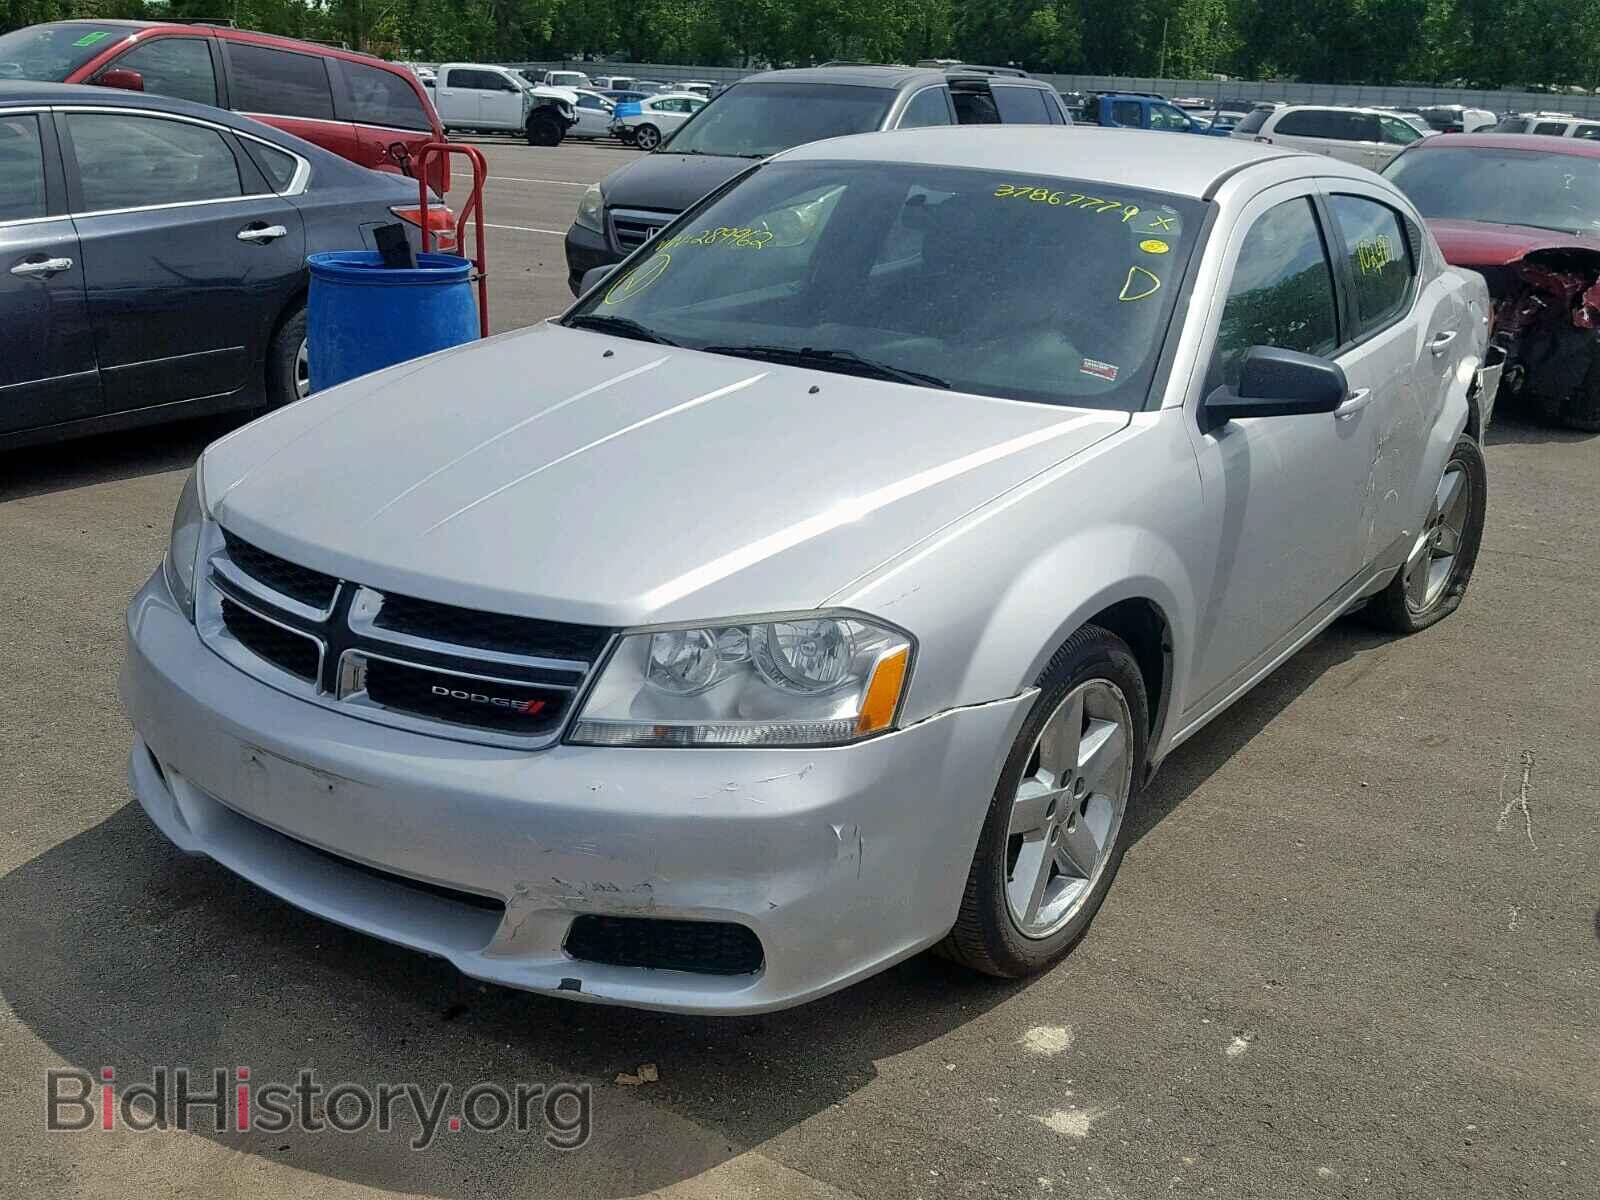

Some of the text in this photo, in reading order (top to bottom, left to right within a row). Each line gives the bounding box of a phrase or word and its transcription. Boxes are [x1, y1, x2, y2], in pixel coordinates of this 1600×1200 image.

[993, 184, 1140, 223] 37867779
[1118, 265, 1161, 301] D
[431, 685, 530, 711] DODGE
